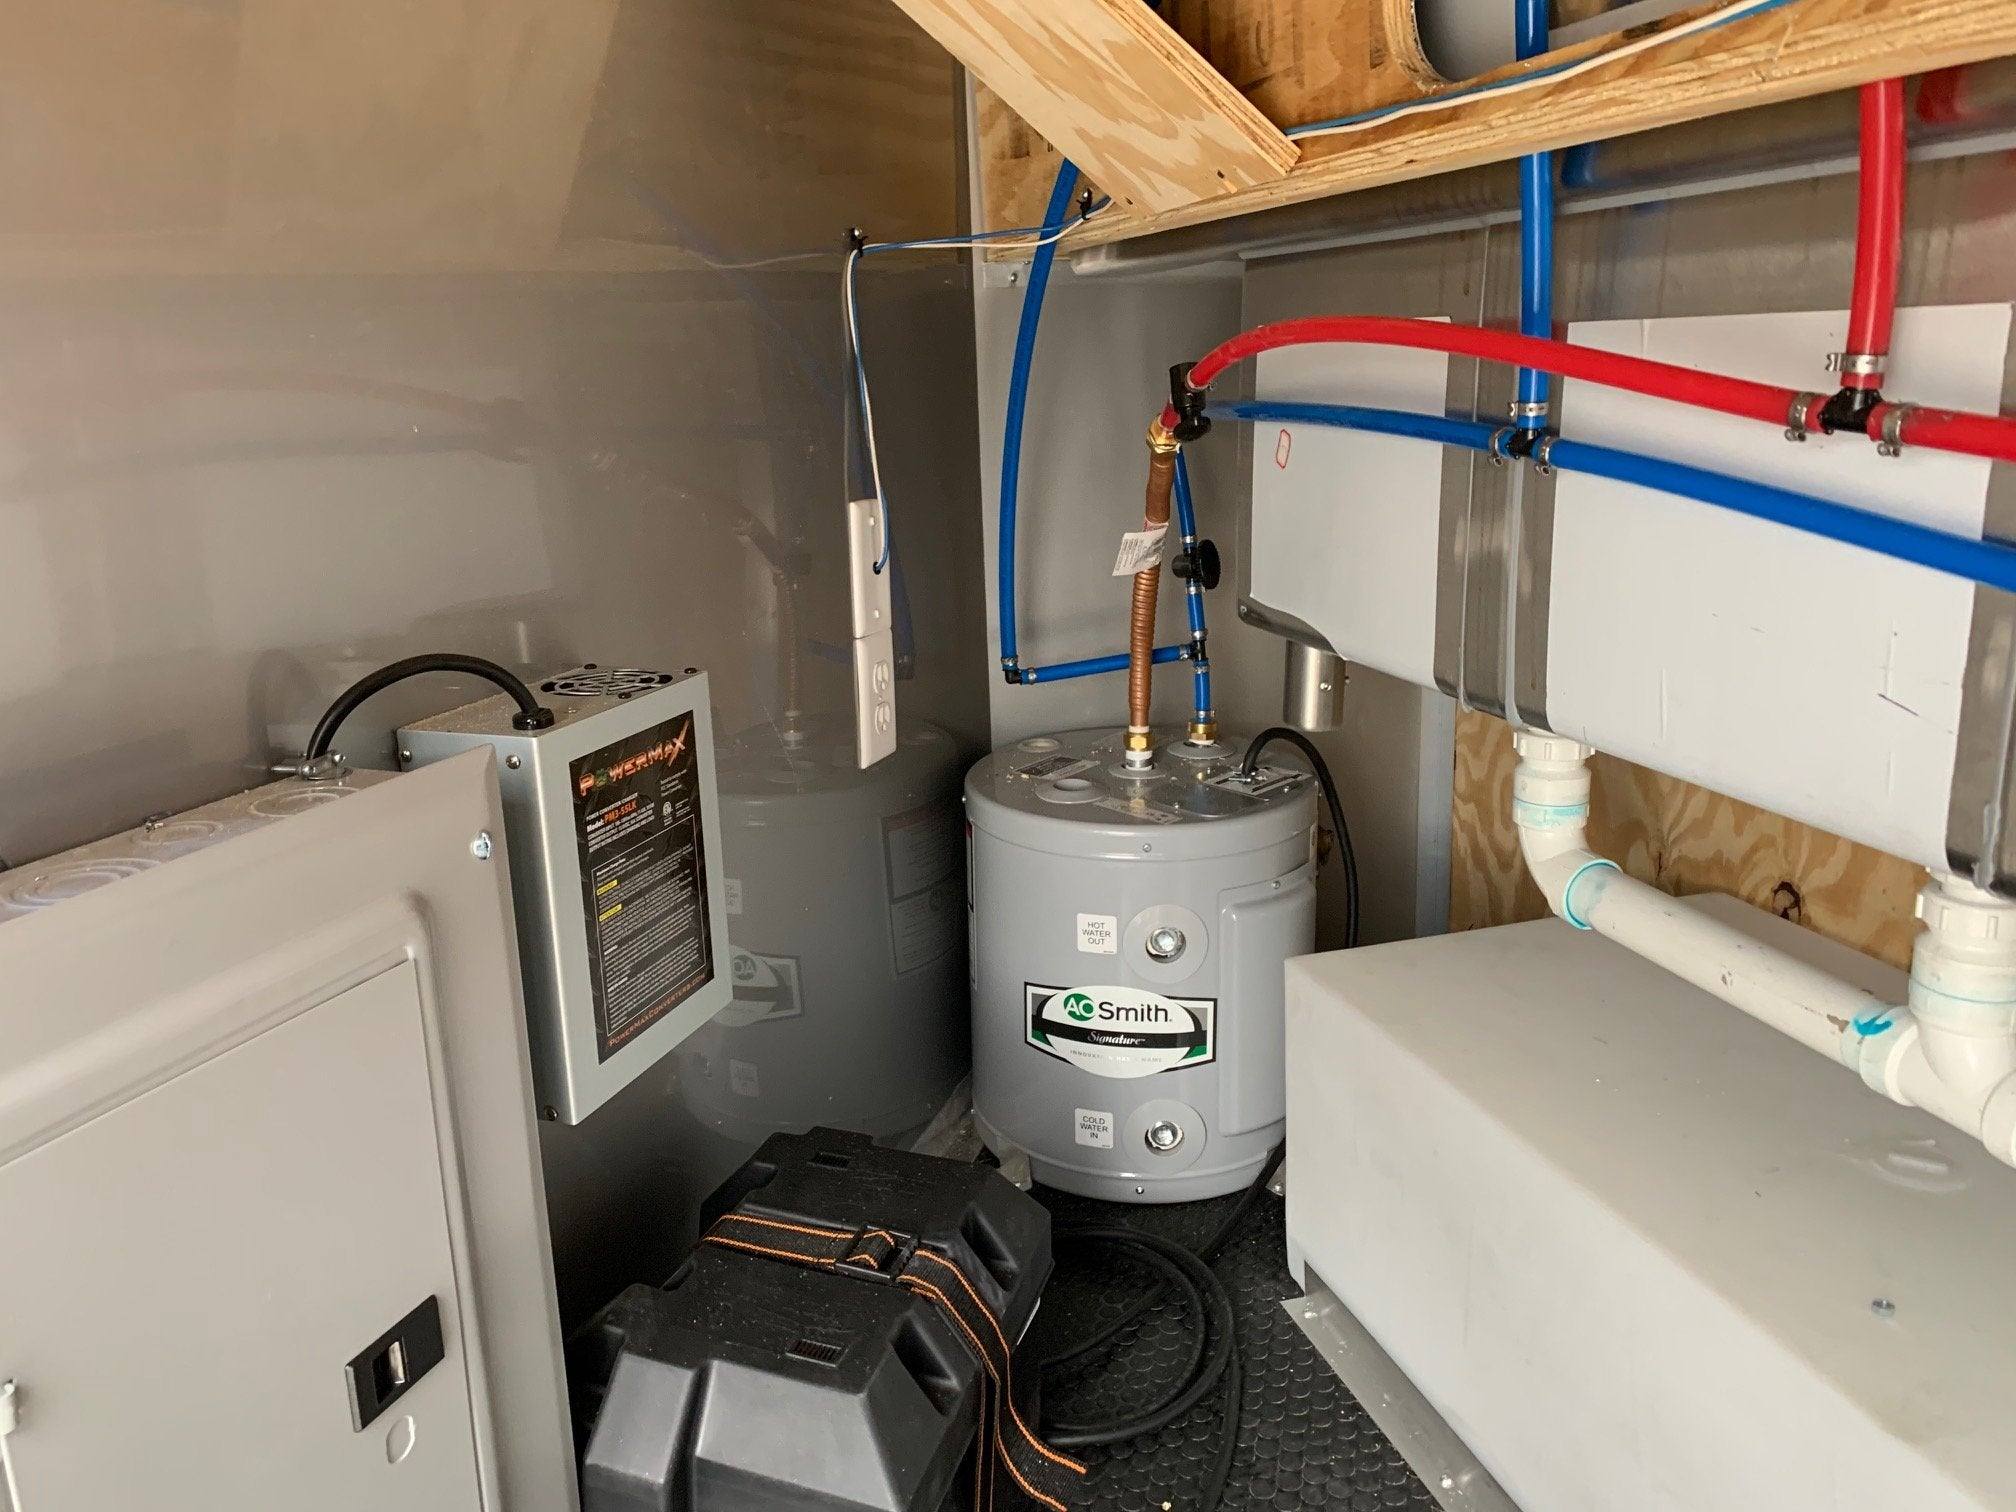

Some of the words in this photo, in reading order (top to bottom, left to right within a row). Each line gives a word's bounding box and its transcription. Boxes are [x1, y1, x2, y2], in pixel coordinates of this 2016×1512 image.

[1087, 921, 1105, 930] HOT
[1082, 929, 1111, 938] WATER
[1087, 937, 1105, 945] OUT
[1087, 1030, 1142, 1045] Signature
[1082, 1115, 1105, 1125] COLD
[1080, 1123, 1108, 1132] WATER
